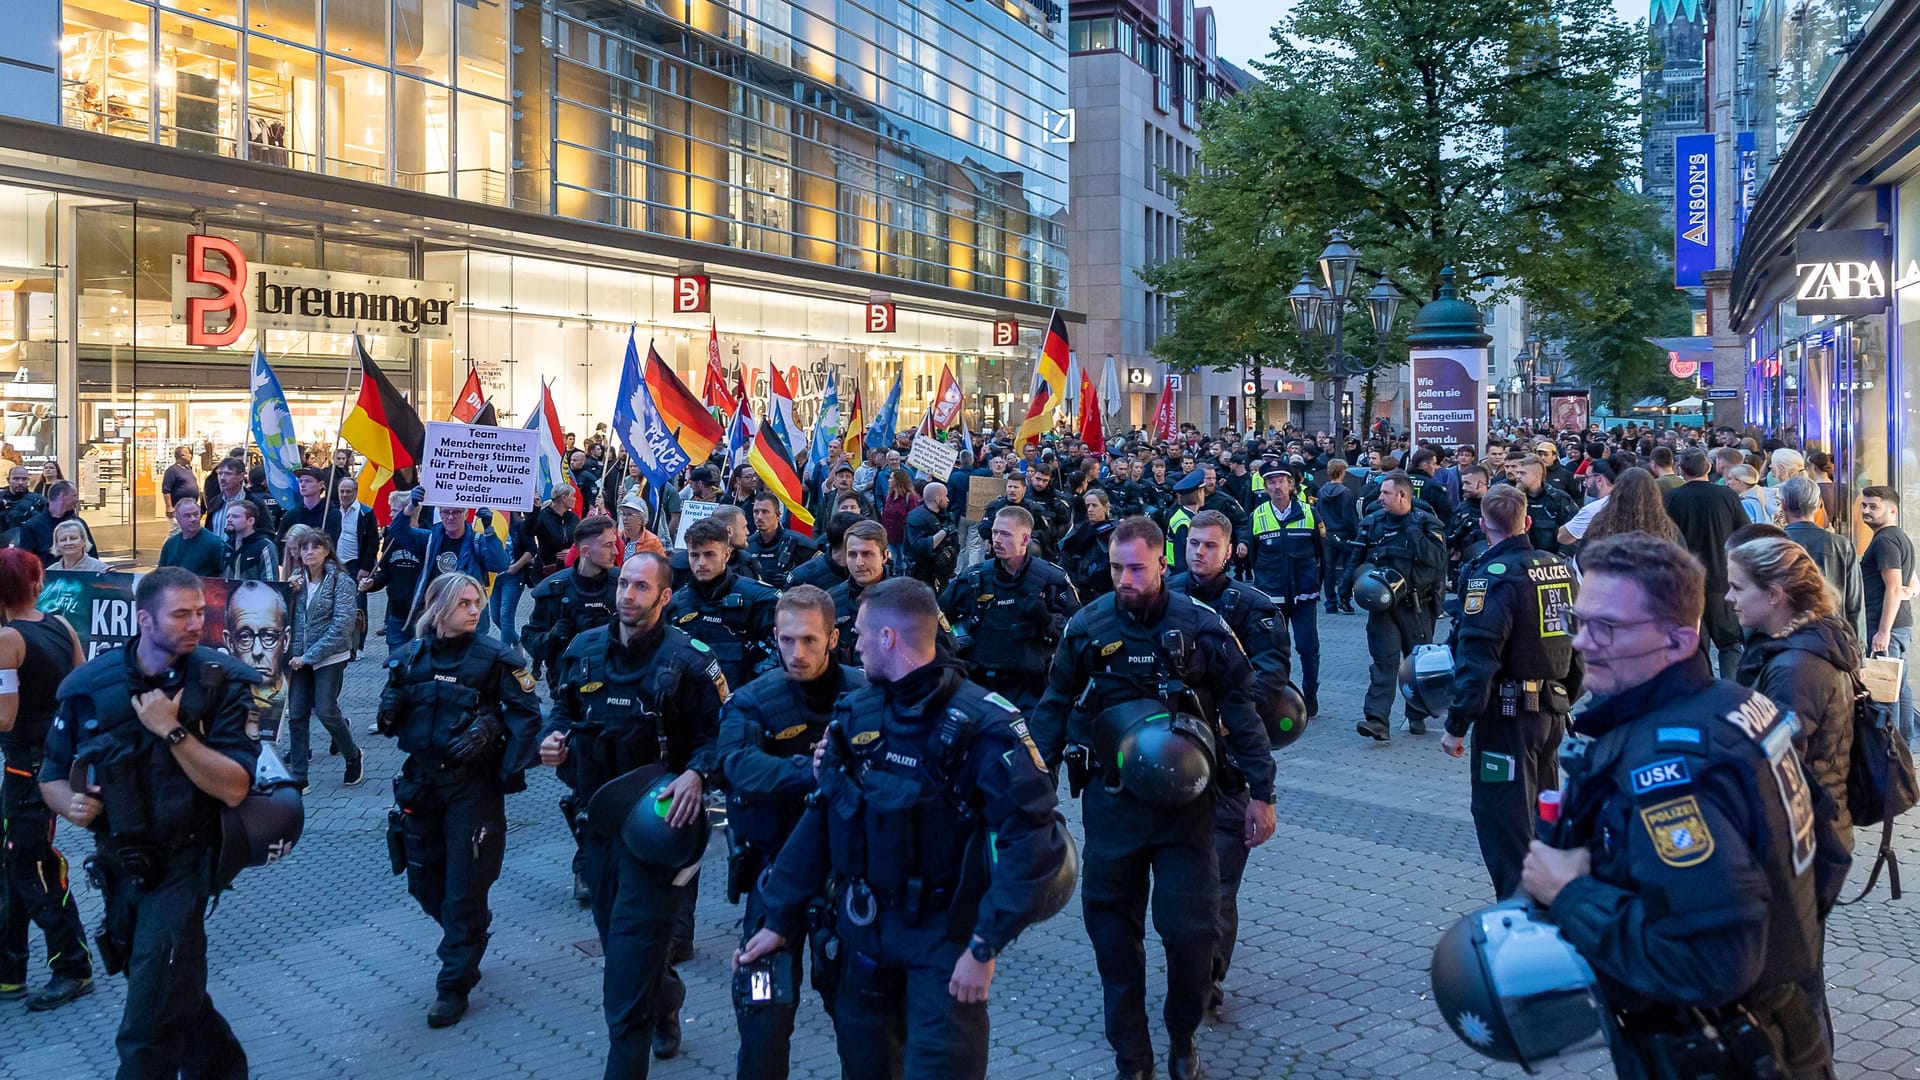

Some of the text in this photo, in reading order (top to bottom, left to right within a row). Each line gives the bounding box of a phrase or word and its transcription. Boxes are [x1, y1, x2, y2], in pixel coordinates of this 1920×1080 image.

[1682, 153, 1708, 246] ANSON'S
[1796, 260, 1885, 300] ZARA
[257, 271, 455, 334] breuninger
[1417, 377, 1433, 386] Wie
[1417, 388, 1461, 398] sollen sie
[1417, 401, 1433, 409] das
[1418, 412, 1472, 422] Evangelium
[469, 428, 498, 439] Team
[1418, 423, 1444, 432] hören
[440, 437, 526, 452] Menschenrechte!
[1443, 435, 1457, 443] du
[645, 422, 686, 473] PEACE
[434, 448, 530, 464] Nürnbergs Stimme
[430, 459, 446, 469] für
[448, 460, 488, 472] Freiheit
[496, 464, 531, 475] Würde
[435, 471, 523, 485] und Demokratie.
[435, 480, 491, 493] Nie wieder
[455, 492, 522, 505] Sozialismus!!!
[1527, 564, 1572, 582] POLIZEI
[1548, 589, 1561, 604] BY
[1128, 655, 1155, 664] POLIZEI
[434, 674, 457, 683] POLIZEI
[606, 697, 631, 706] POLIZEI
[885, 751, 917, 768] POLIZEI
[1639, 763, 1682, 787] USK
[1648, 802, 1694, 825] POLIZEI
